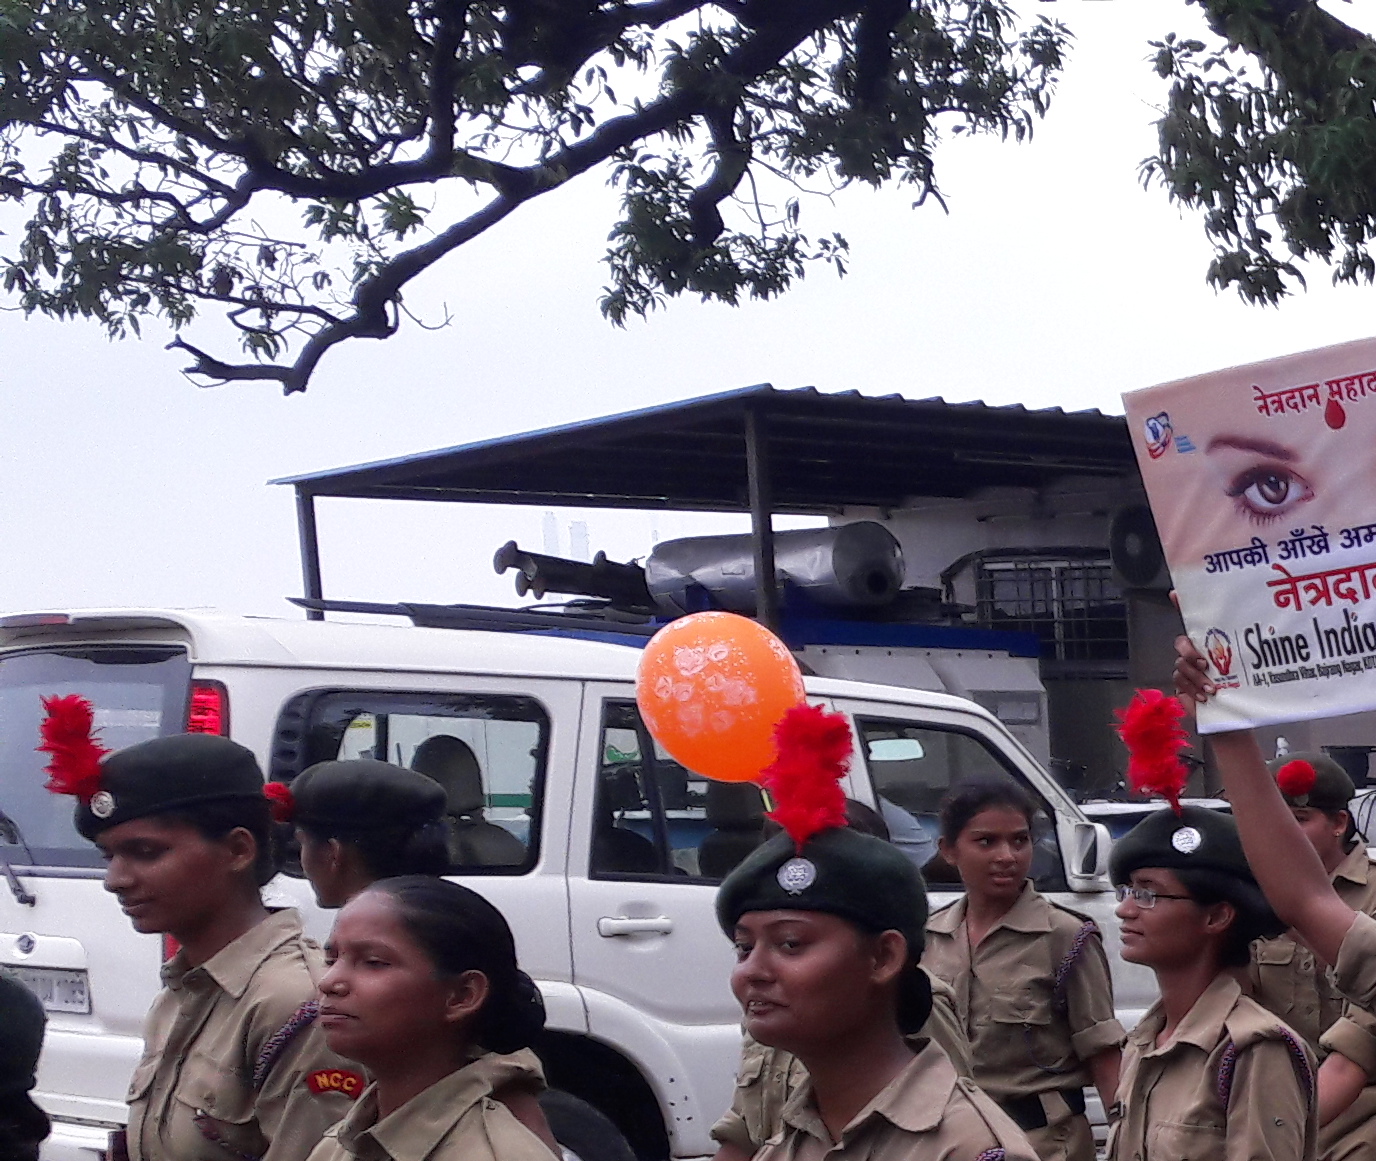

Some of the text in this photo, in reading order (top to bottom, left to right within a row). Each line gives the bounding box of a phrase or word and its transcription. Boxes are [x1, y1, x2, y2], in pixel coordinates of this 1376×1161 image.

[1252, 384, 1321, 417] नेत्रदान
[1204, 536, 1270, 574] आपकी
[1277, 525, 1330, 560] आँखें
[1244, 622, 1311, 670] Shine
[314, 1073, 357, 1091] NCC
